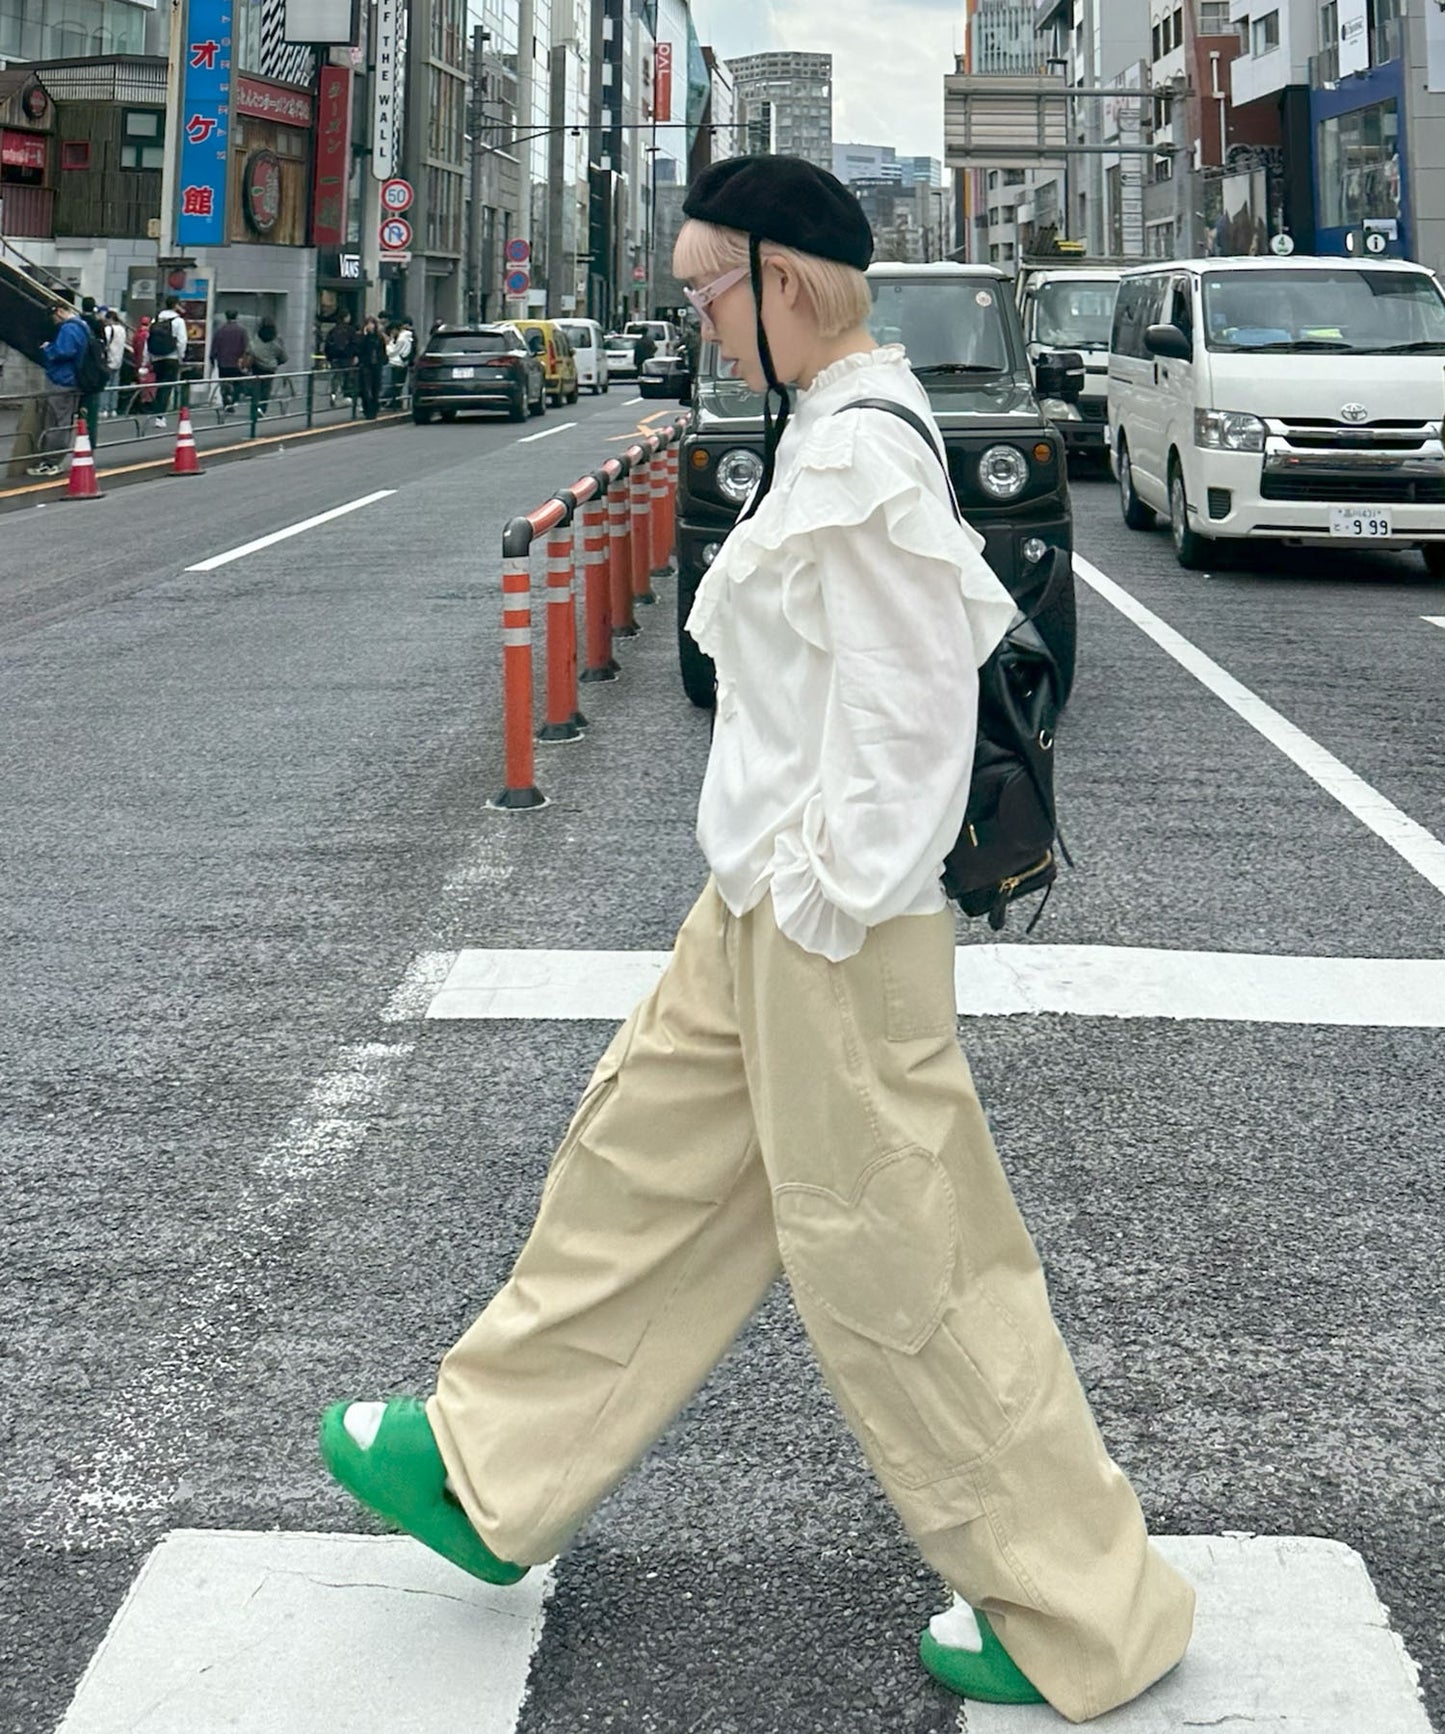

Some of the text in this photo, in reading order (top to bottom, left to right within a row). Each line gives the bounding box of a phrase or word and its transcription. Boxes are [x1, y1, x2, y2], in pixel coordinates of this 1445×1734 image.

[381, 36, 391, 81] THE
[379, 95, 391, 158] WALL
[388, 188, 407, 204] 50
[340, 254, 360, 279] VANS
